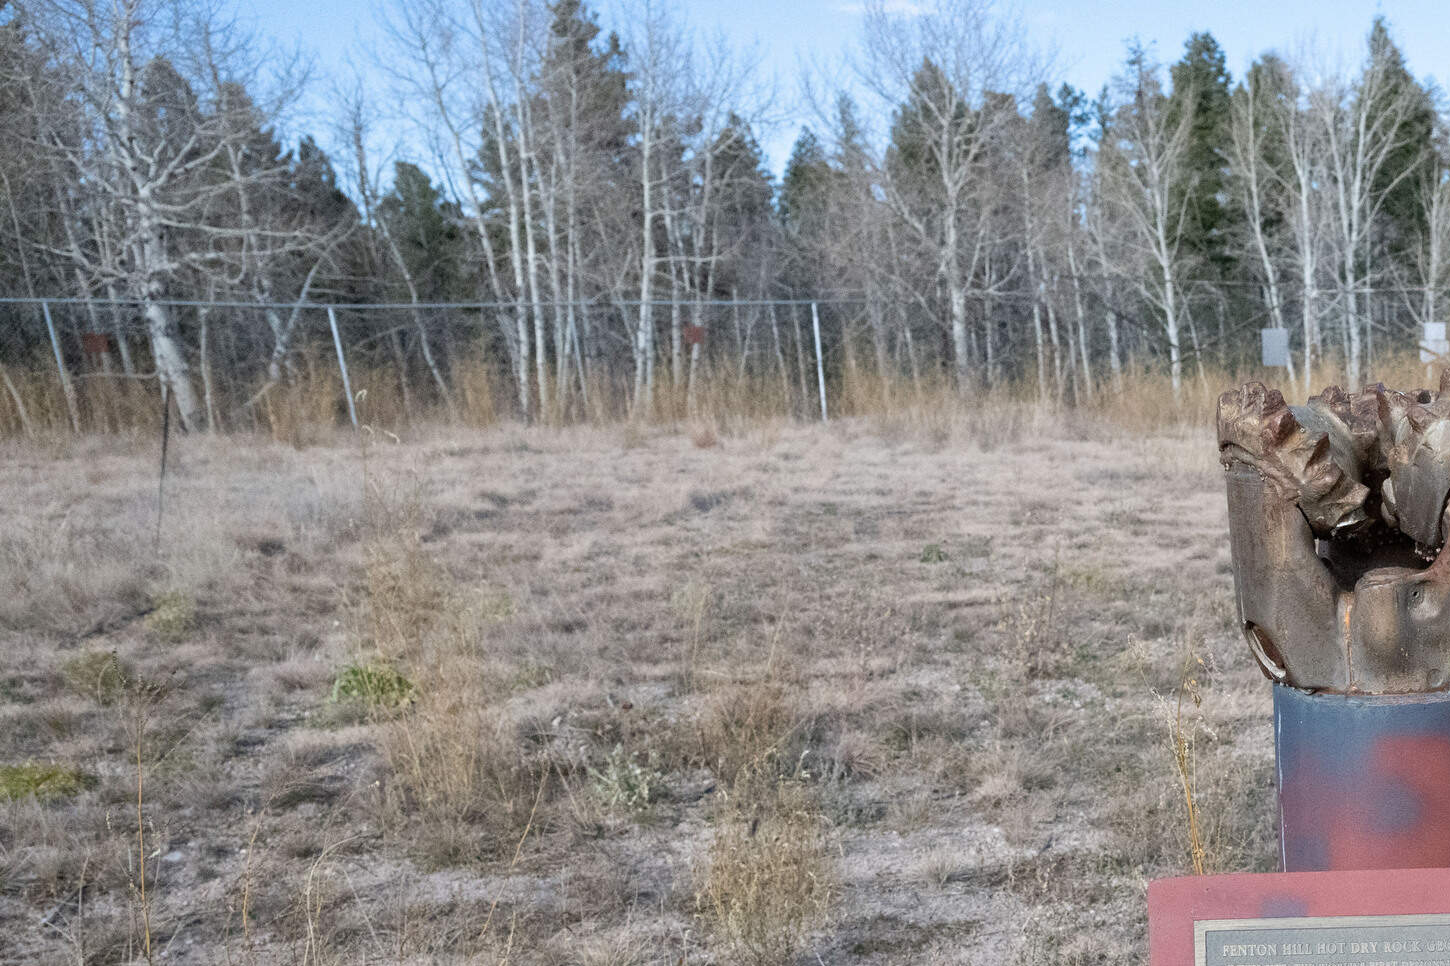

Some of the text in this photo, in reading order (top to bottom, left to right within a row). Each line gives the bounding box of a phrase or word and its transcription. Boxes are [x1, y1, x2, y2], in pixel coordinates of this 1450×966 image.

[1223, 943, 1277, 958] FENTON
[1282, 942, 1312, 957] HILL
[1316, 941, 1345, 956] HOT
[1350, 940, 1378, 955] DRY
[1383, 939, 1422, 954] ROCK
